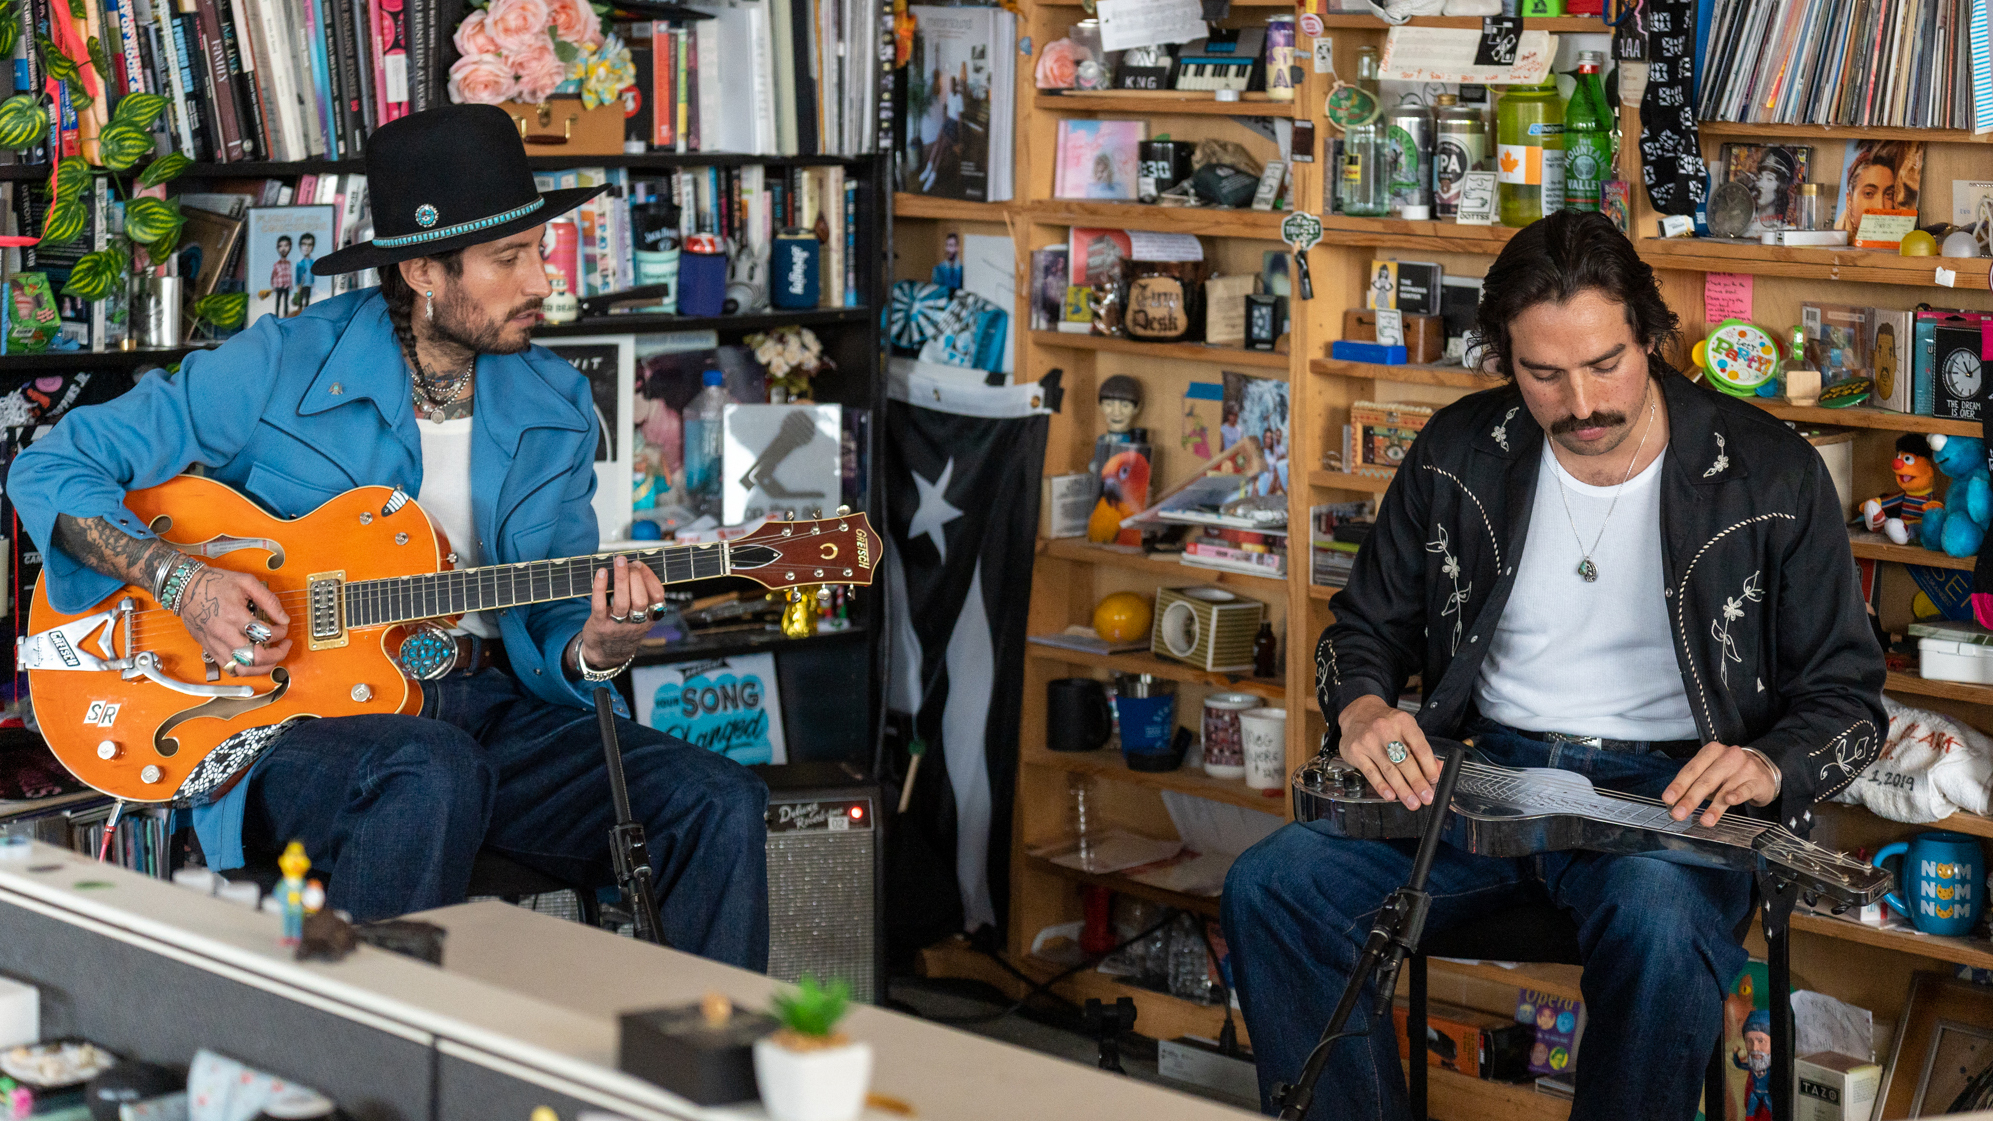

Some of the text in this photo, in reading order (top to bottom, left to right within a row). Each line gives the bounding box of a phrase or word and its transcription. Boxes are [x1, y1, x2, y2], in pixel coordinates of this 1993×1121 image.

[342, 13, 354, 56] ROLLING
[414, 12, 425, 67] BERNSTEIN
[122, 37, 136, 79] ROCK
[416, 69, 426, 81] AT
[347, 59, 358, 98] STONES
[1124, 76, 1158, 88] KNG
[1132, 310, 1179, 333] Desk
[1946, 400, 1981, 411] THE DREAM
[1951, 408, 1976, 418] IS OVER
[855, 528, 870, 570] GRETSCH
[50, 632, 79, 667] GRETSCH
[681, 682, 759, 718] SONG
